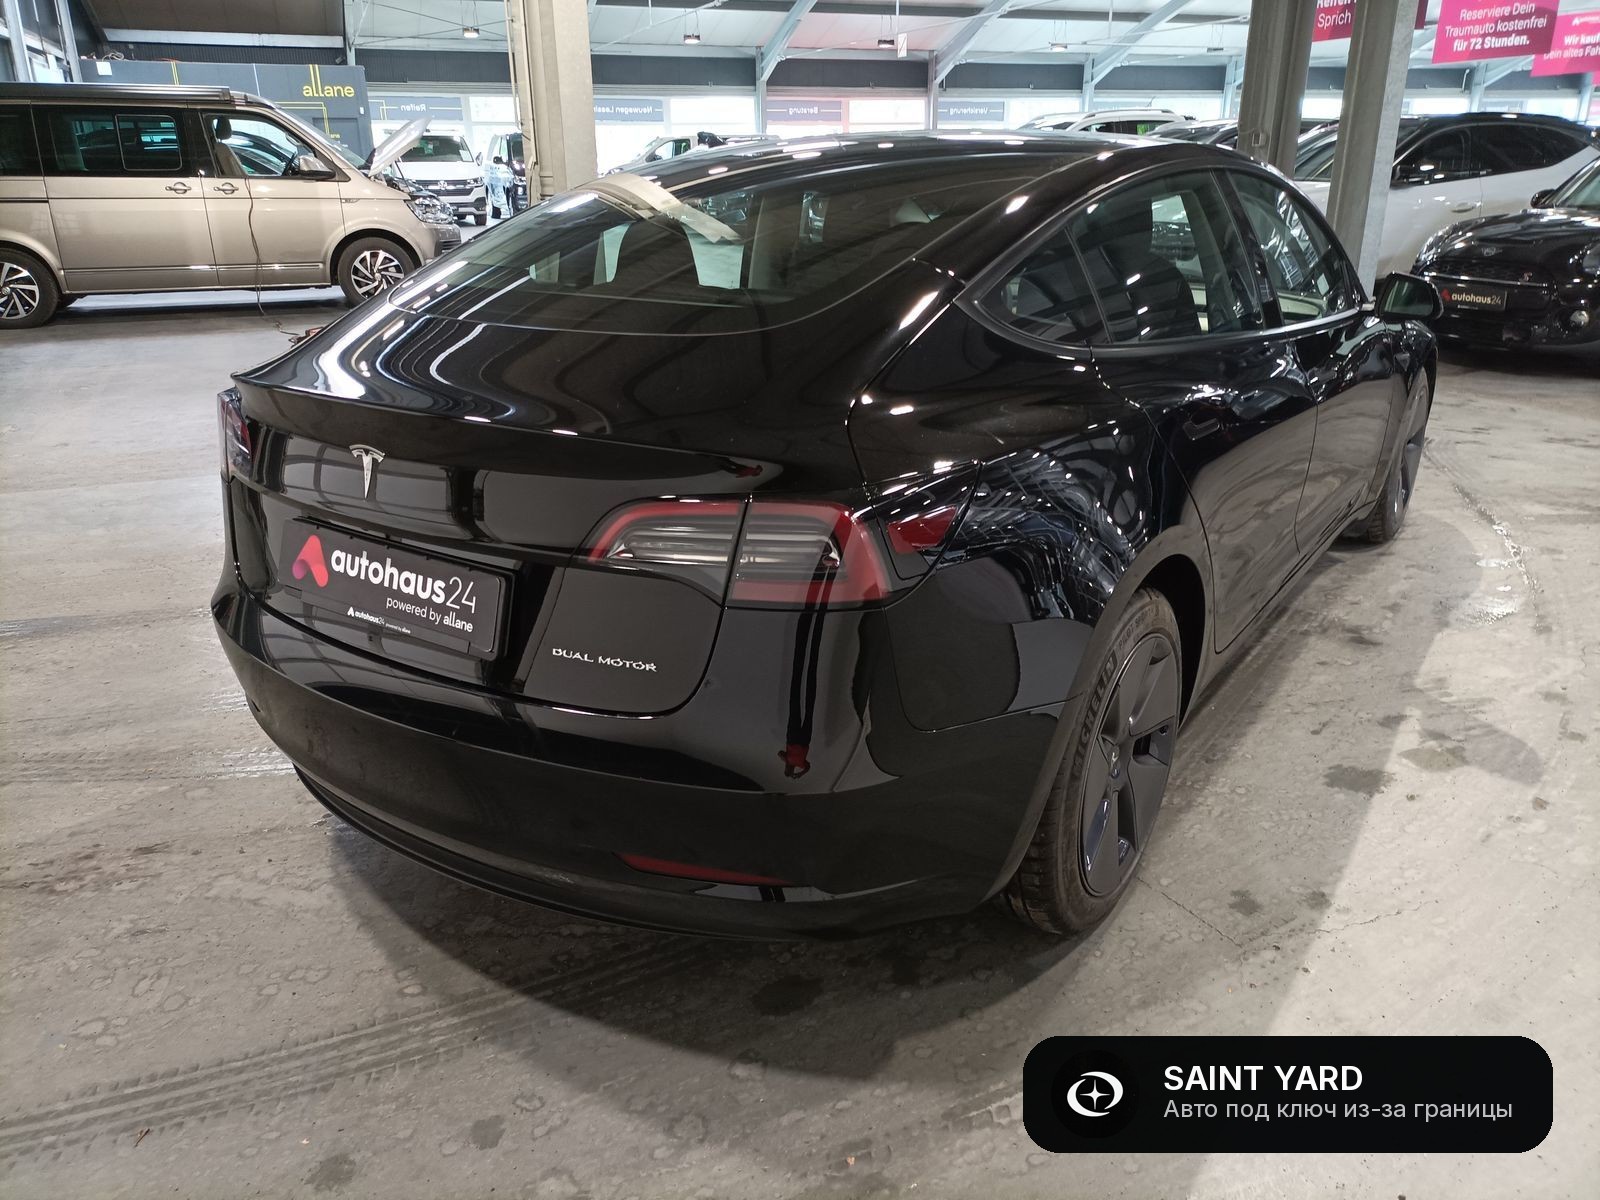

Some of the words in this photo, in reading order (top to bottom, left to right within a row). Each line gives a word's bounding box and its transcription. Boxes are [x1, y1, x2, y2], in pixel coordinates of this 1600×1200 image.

[1317, 9, 1351, 30] Sprich
[1460, 6, 1511, 20] Reserviere
[1512, 2, 1535, 15] Dein
[1445, 22, 1495, 38] Traumauto
[1496, 14, 1547, 32] kostenfrei
[1453, 38, 1467, 52] für
[1469, 37, 1482, 50] 72
[1483, 33, 1530, 49] Stunden.
[1564, 35, 1580, 46] Wir
[1563, 48, 1583, 58] altes
[1451, 292, 1502, 305] autohaus24
[331, 549, 477, 614] autohaus24
[386, 597, 428, 618] powered
[428, 607, 442, 625] by
[443, 611, 474, 633] allane
[552, 648, 594, 662] DUAL
[598, 656, 657, 672] MOTOR
